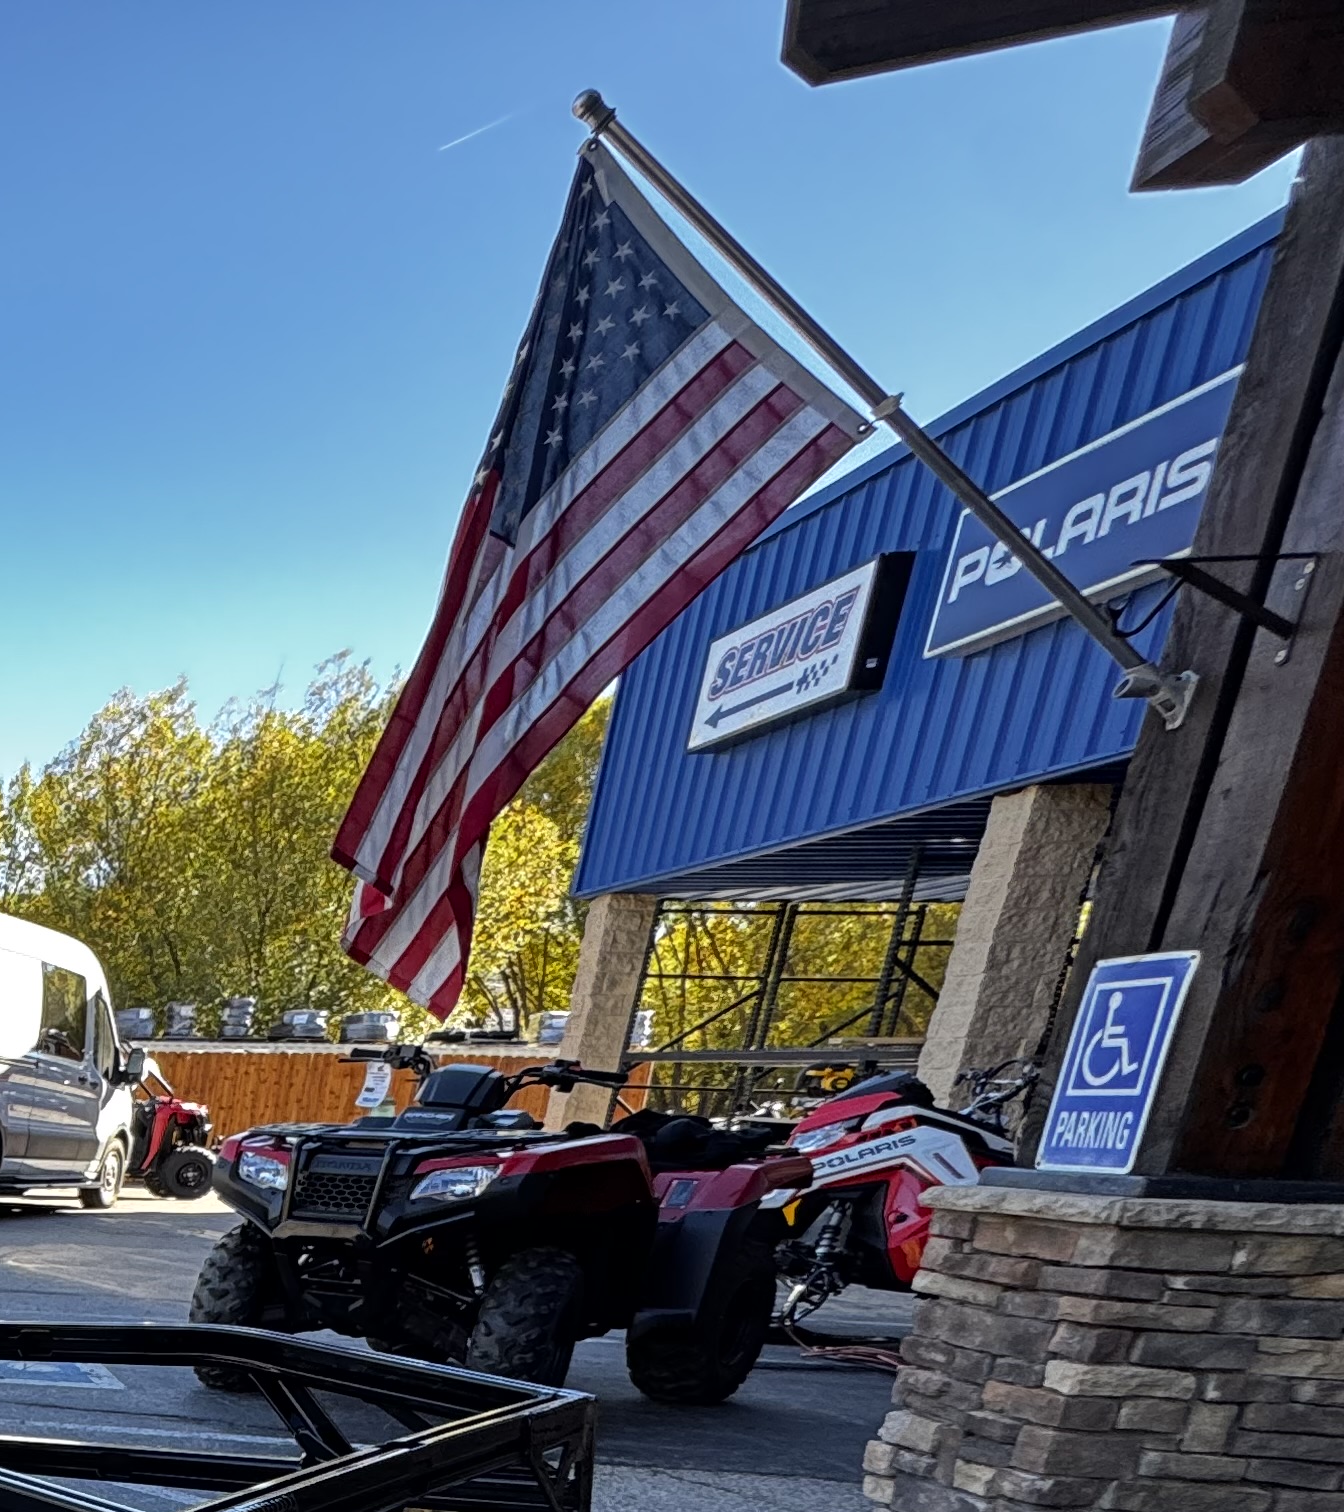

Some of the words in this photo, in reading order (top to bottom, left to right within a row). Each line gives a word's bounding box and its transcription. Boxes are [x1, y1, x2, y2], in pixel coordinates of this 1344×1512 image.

[947, 437, 1218, 604] POLARIS
[708, 586, 860, 701] SERVICE
[812, 1135, 917, 1171] POLARIS
[1050, 1110, 1134, 1150] PARKING
